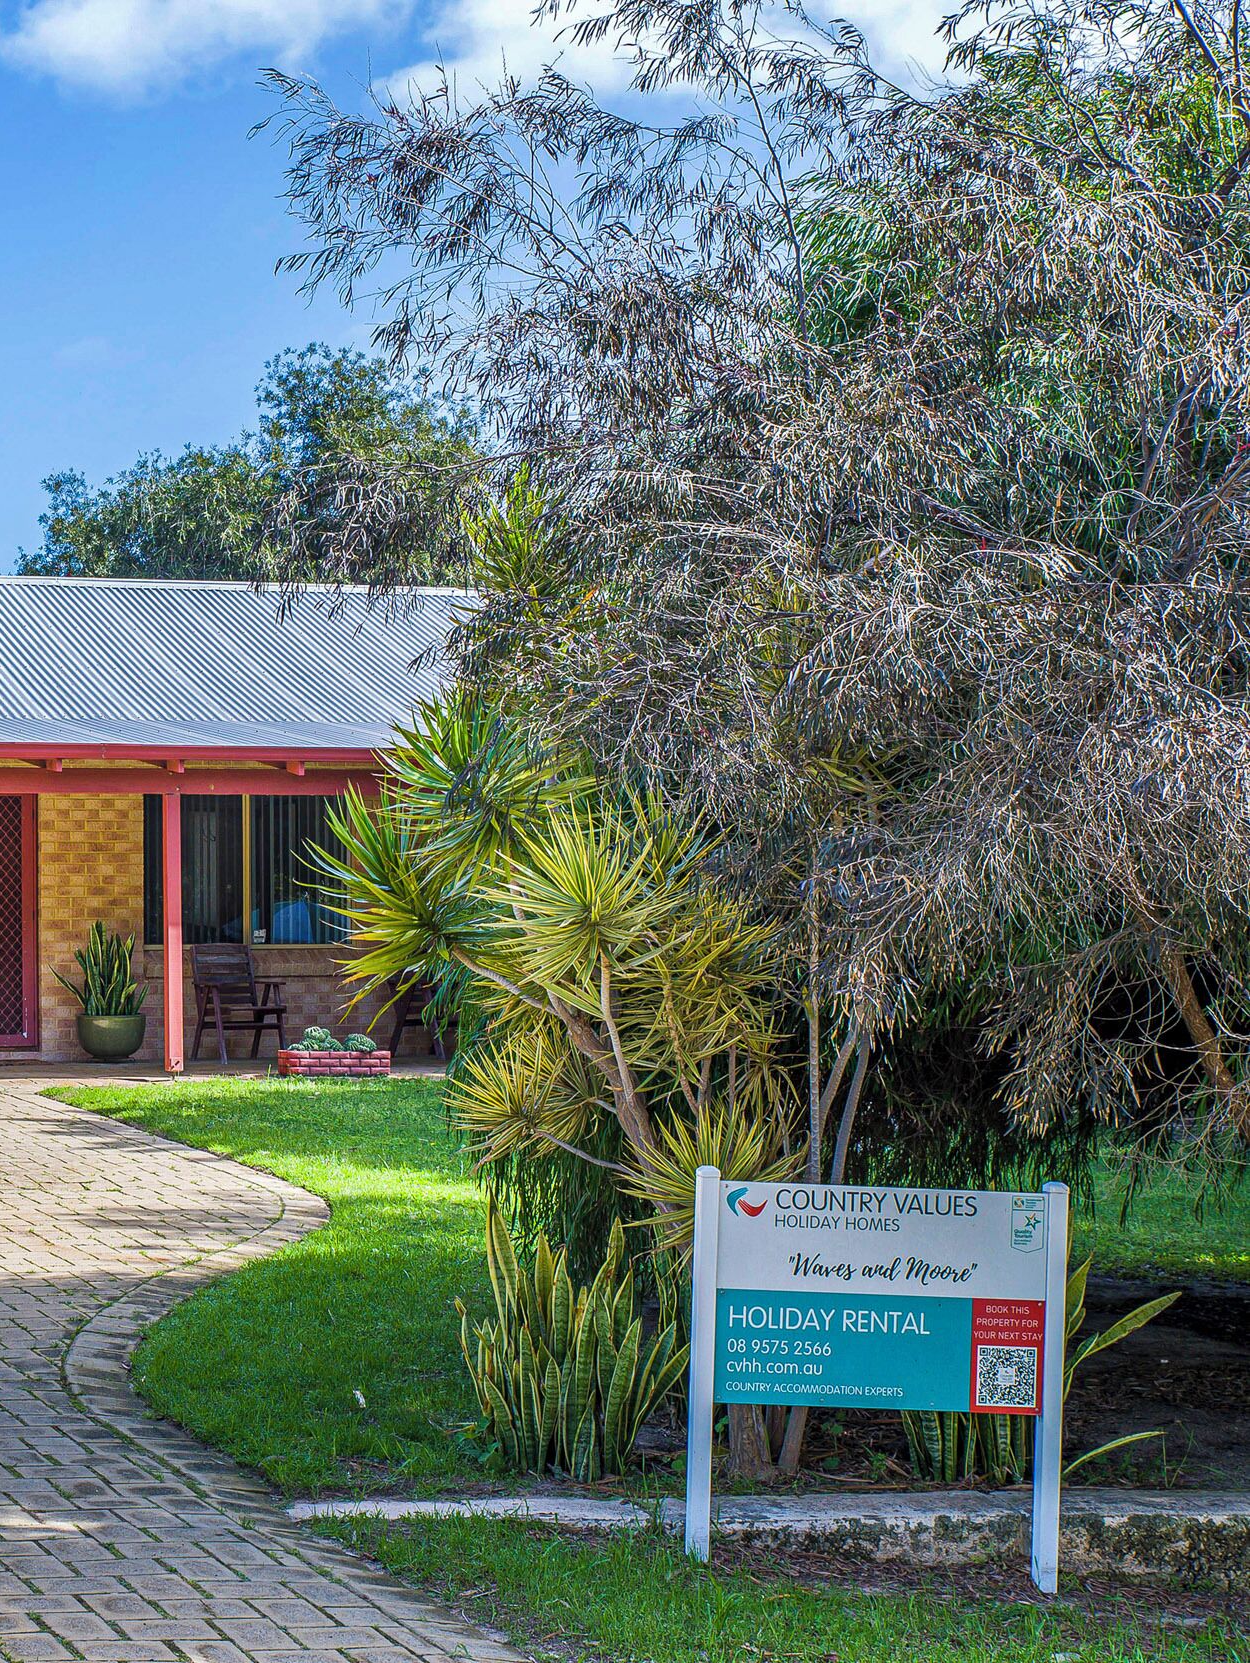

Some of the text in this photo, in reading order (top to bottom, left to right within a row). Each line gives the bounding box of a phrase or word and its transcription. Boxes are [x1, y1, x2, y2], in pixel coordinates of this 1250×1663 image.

[775, 1188, 978, 1217] COUNTRY VALUES
[774, 1213, 900, 1232] HOLIDAY HOMES
[788, 1252, 978, 1286] "Waves and Moore"
[985, 1305, 1030, 1315] BOOK THIS
[729, 1305, 930, 1335] HOLIDAY RENTAL
[976, 1317, 1039, 1328] PROPERTY FOR
[973, 1330, 1043, 1341] YOUR NEXT STAY
[727, 1338, 832, 1357] 08 9575 2566
[726, 1357, 823, 1376] cvhh.com.au
[725, 1381, 904, 1397] COUNTRY ACCOMMODATION EXPERTS
